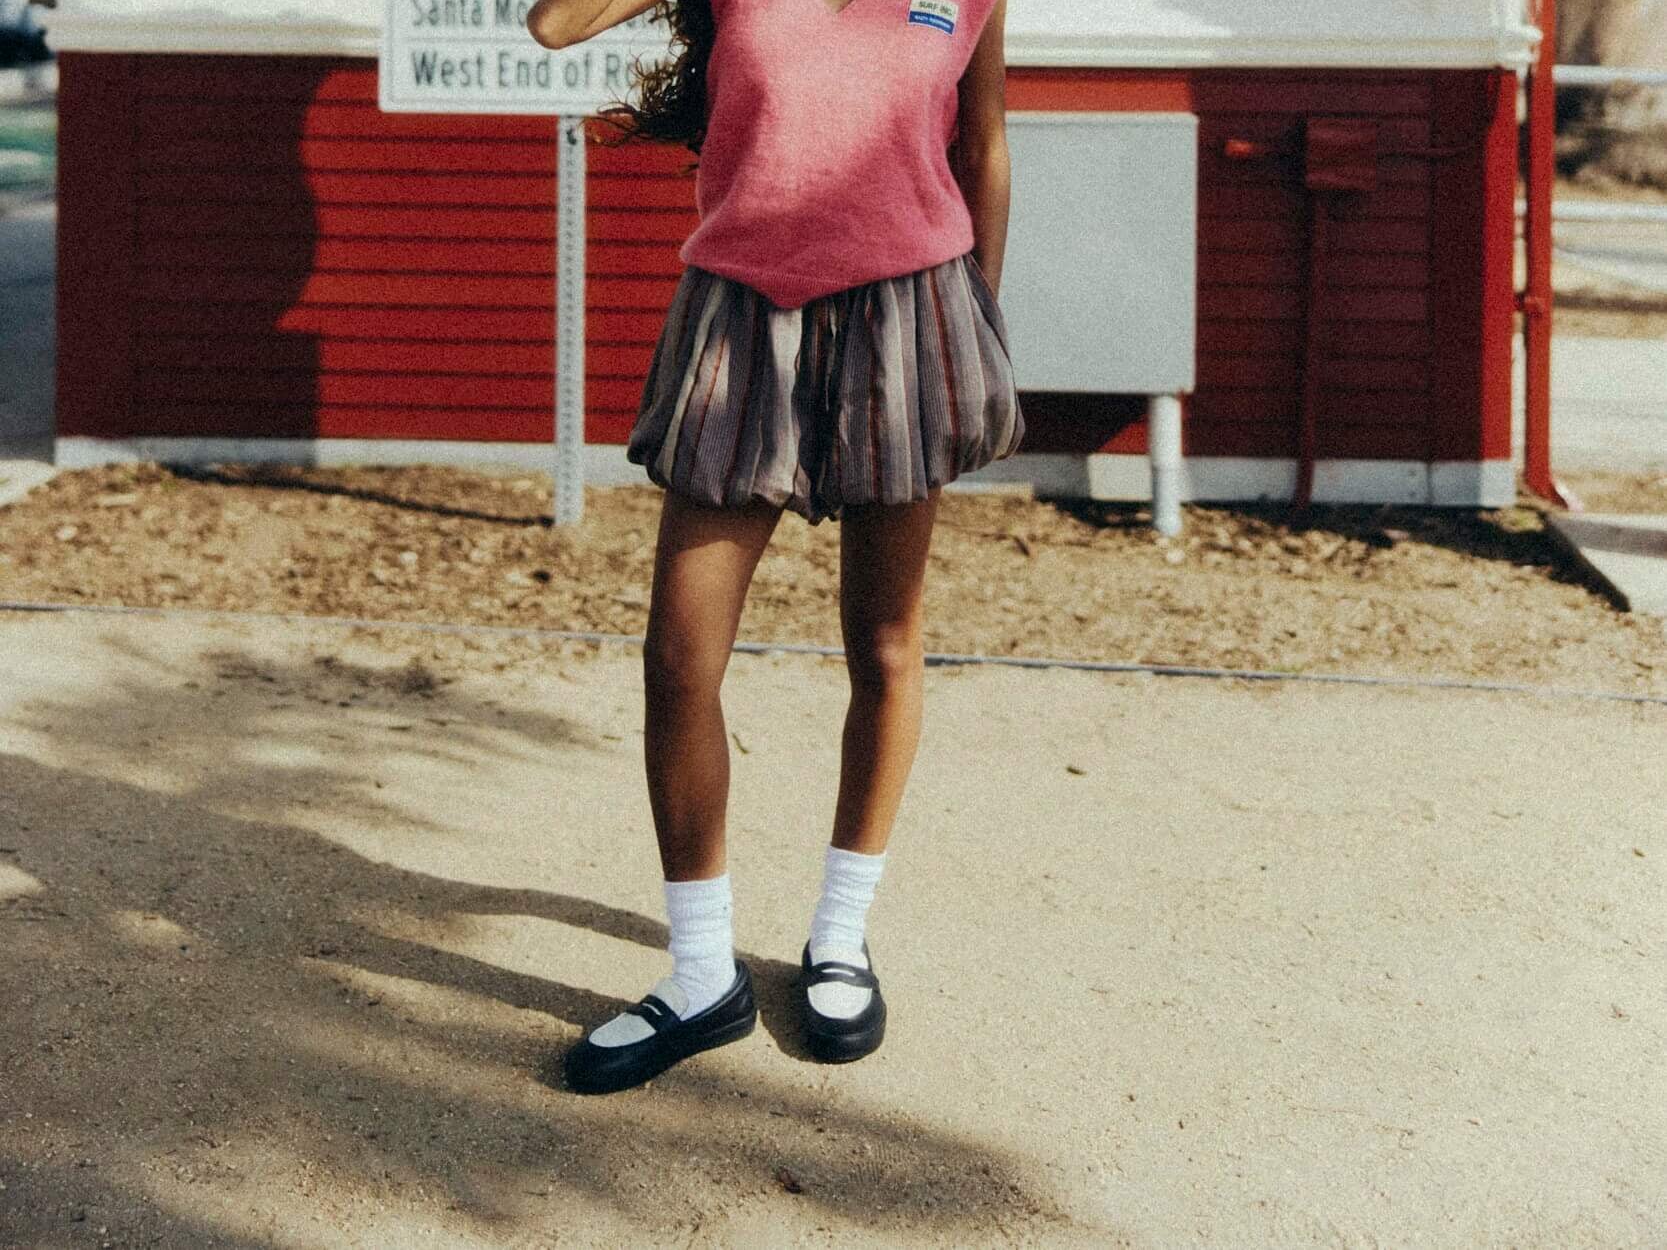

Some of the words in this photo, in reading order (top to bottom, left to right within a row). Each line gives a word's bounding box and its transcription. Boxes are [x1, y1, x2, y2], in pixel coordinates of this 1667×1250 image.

[411, 52, 485, 88] West
[497, 52, 551, 89] End
[562, 52, 594, 89] of
